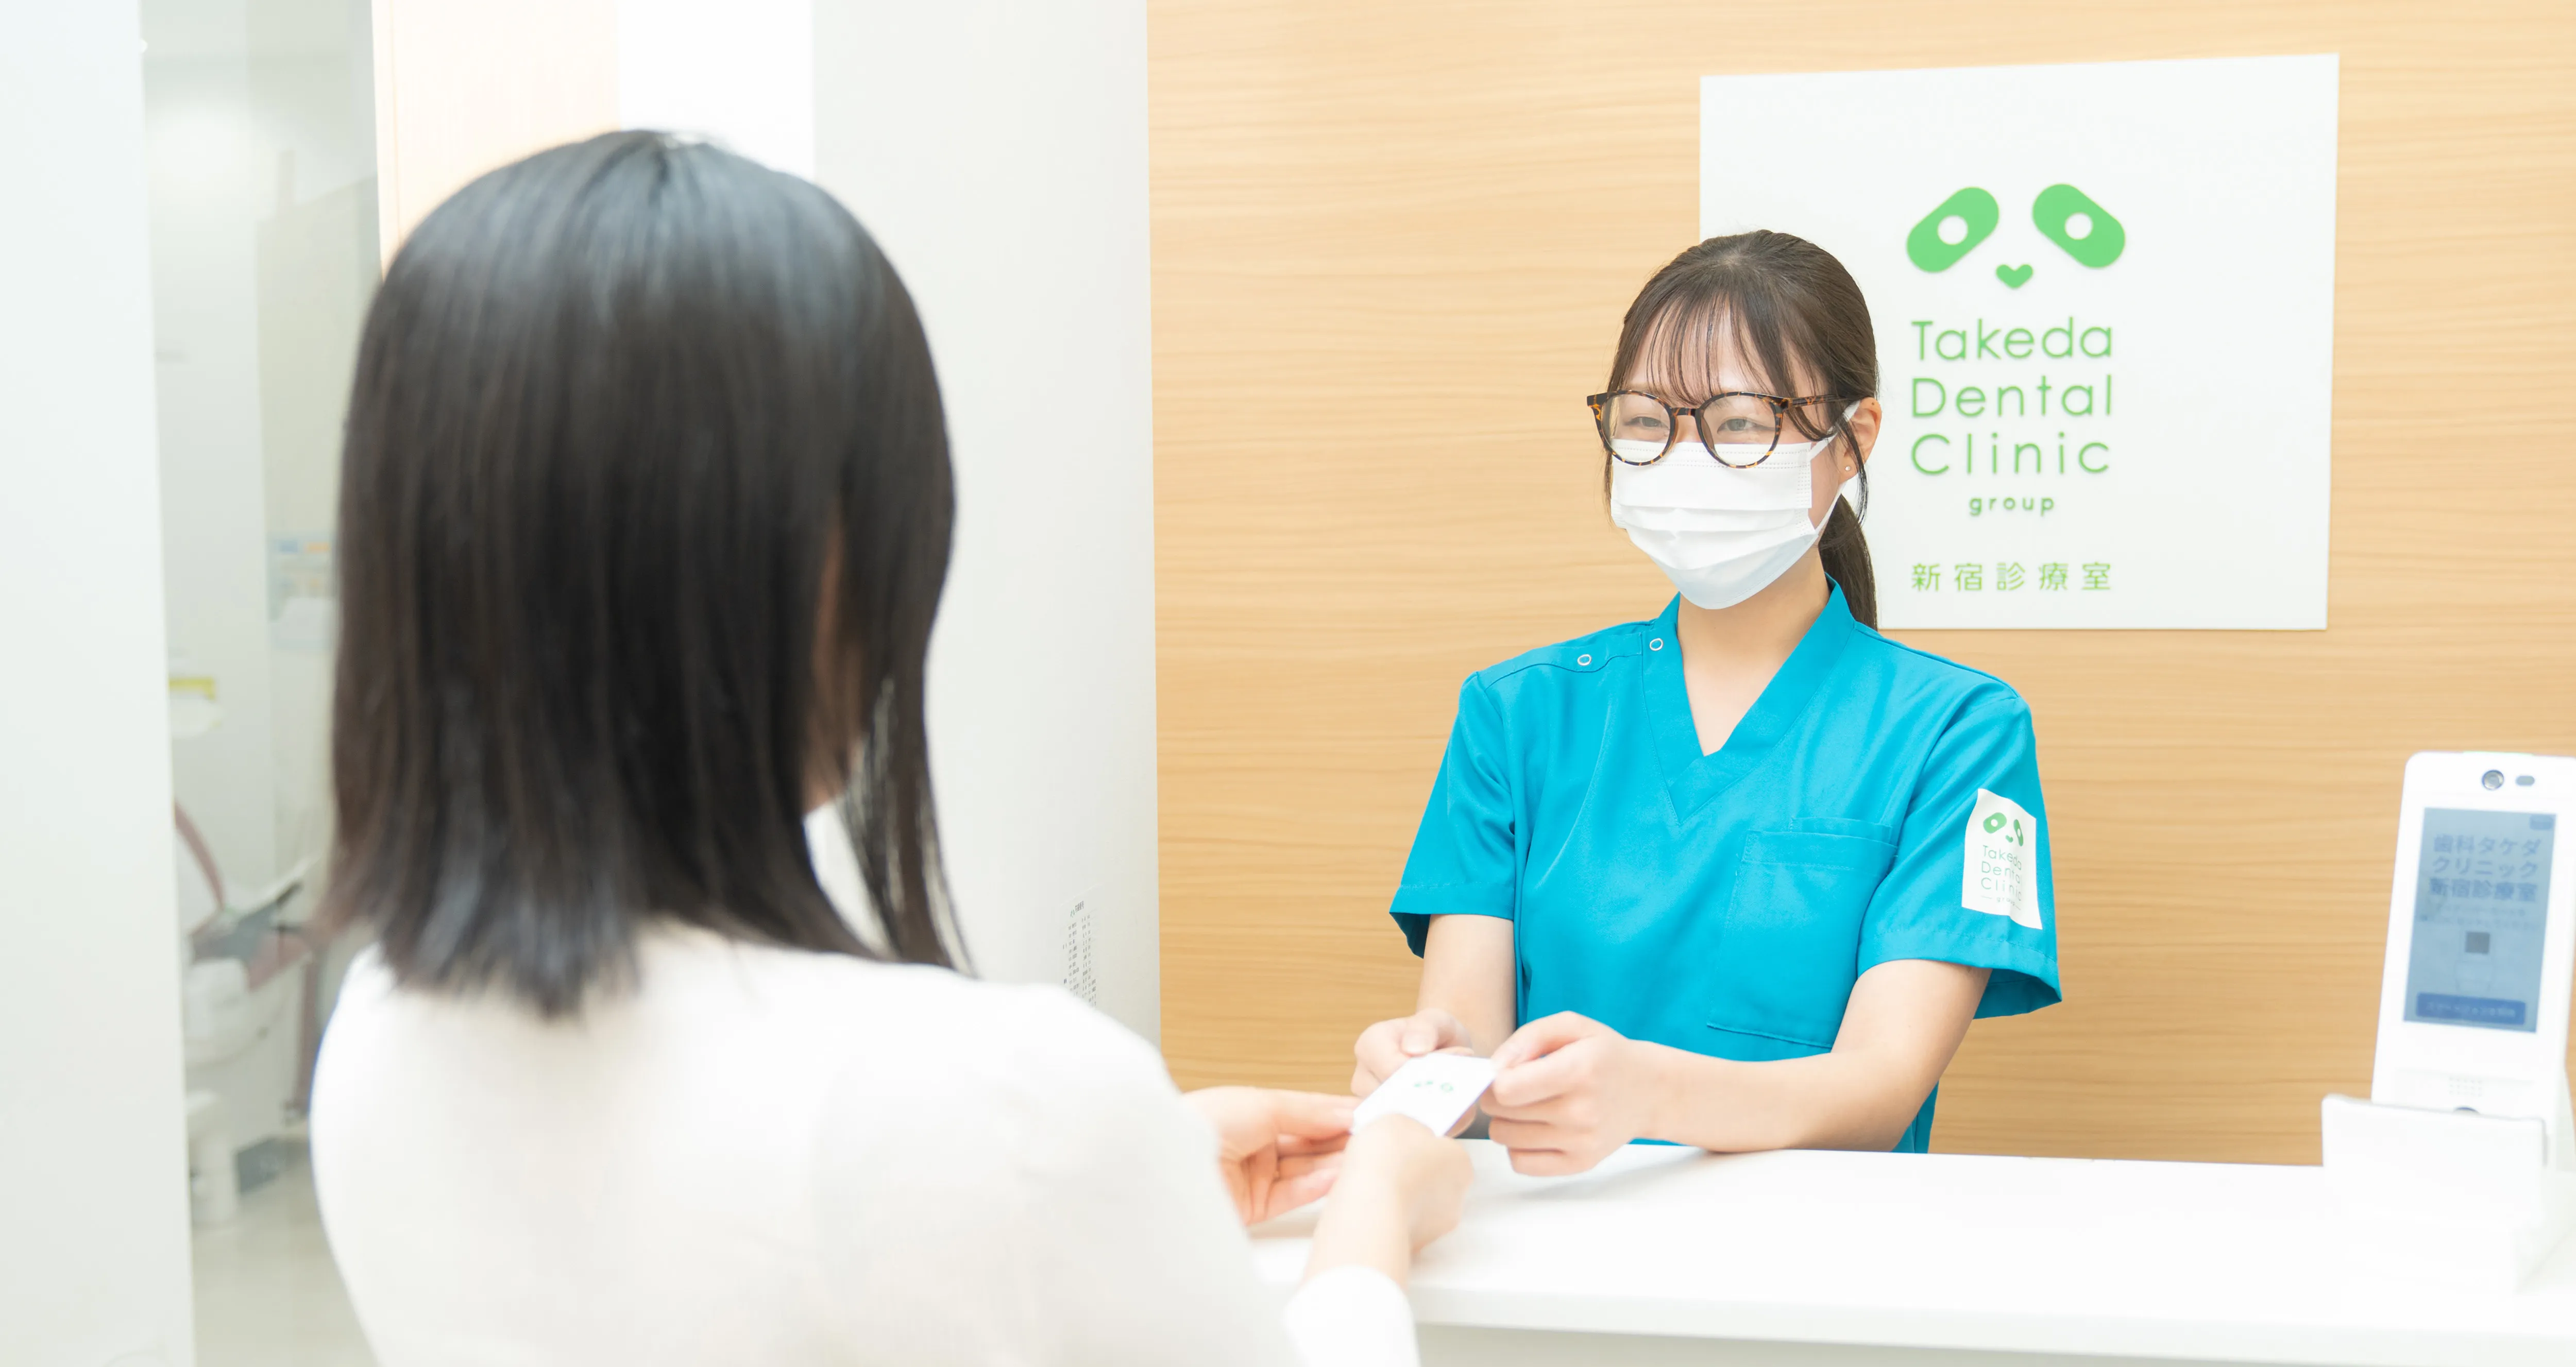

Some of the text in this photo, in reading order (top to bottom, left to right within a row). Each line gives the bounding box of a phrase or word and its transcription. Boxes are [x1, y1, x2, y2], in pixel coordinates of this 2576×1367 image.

[1910, 316, 2112, 361] Takeda
[1911, 374, 2112, 418] Dental
[1910, 431, 2110, 475] Clinic
[1969, 497, 2055, 517] group
[1911, 561, 2111, 591] 新宿診療室
[1982, 844, 2022, 870] Takeda
[2433, 833, 2542, 857] 歯科タケダ
[1981, 861, 2022, 888] Dental
[2432, 856, 2538, 878] クリニック
[1981, 877, 2022, 902] Clinic
